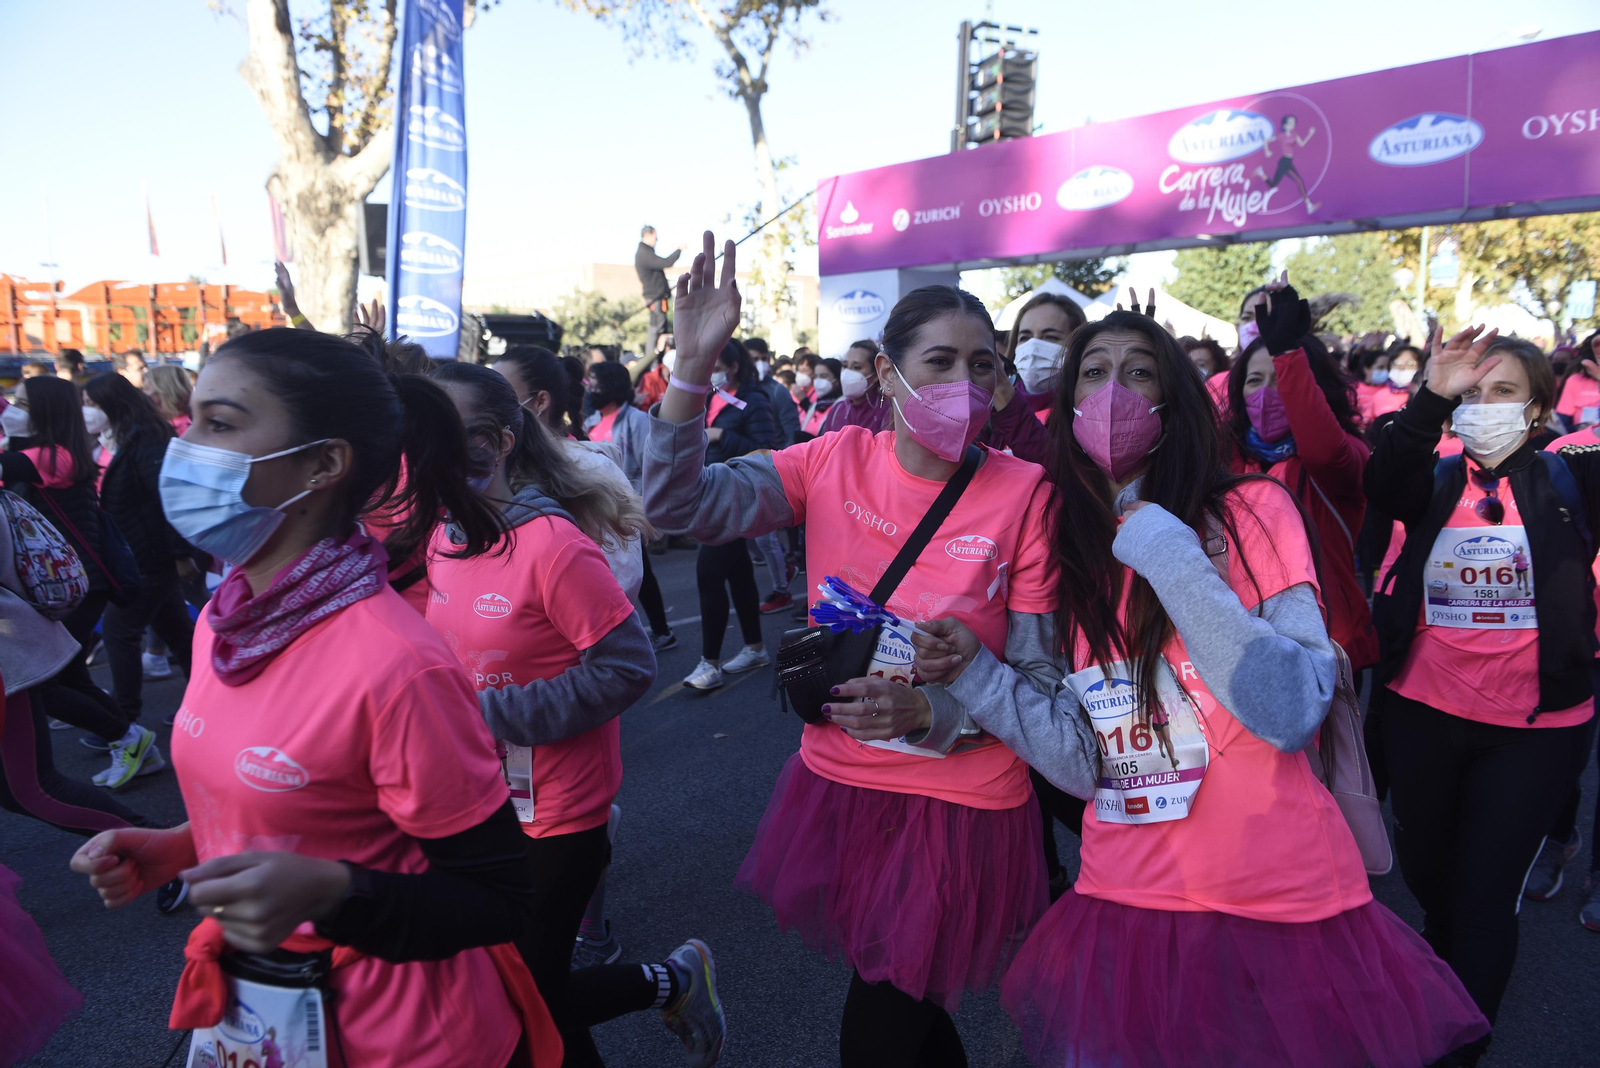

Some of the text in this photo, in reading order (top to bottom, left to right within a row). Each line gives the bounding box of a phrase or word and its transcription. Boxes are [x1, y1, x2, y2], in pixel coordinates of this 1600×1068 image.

[1376, 132, 1475, 159] ASTURIANA
[1158, 163, 1247, 195] Carrera
[978, 191, 1043, 218] OYSHO
[1178, 179, 1279, 228] de la Mujer
[913, 205, 960, 225] ZURICH
[826, 222, 874, 240] Santander
[844, 500, 898, 537] OYSHO
[949, 542, 994, 558] ASTURIANA
[1458, 546, 1512, 556] ASTURIANA
[1460, 566, 1514, 585] 016
[1448, 599, 1480, 607] CARRERA
[1504, 599, 1531, 607] MUJER
[1473, 589, 1500, 599] 1581
[476, 600, 510, 614] ASTURIANA
[1432, 610, 1468, 622] OYSHO
[475, 672, 514, 686] POR
[1085, 694, 1138, 712] ASTURIAN
[1096, 723, 1153, 757] 016
[237, 754, 301, 786] ASTURIANA
[1120, 778, 1130, 789] DE
[1131, 776, 1144, 788] LA
[1146, 772, 1180, 786] MUJER
